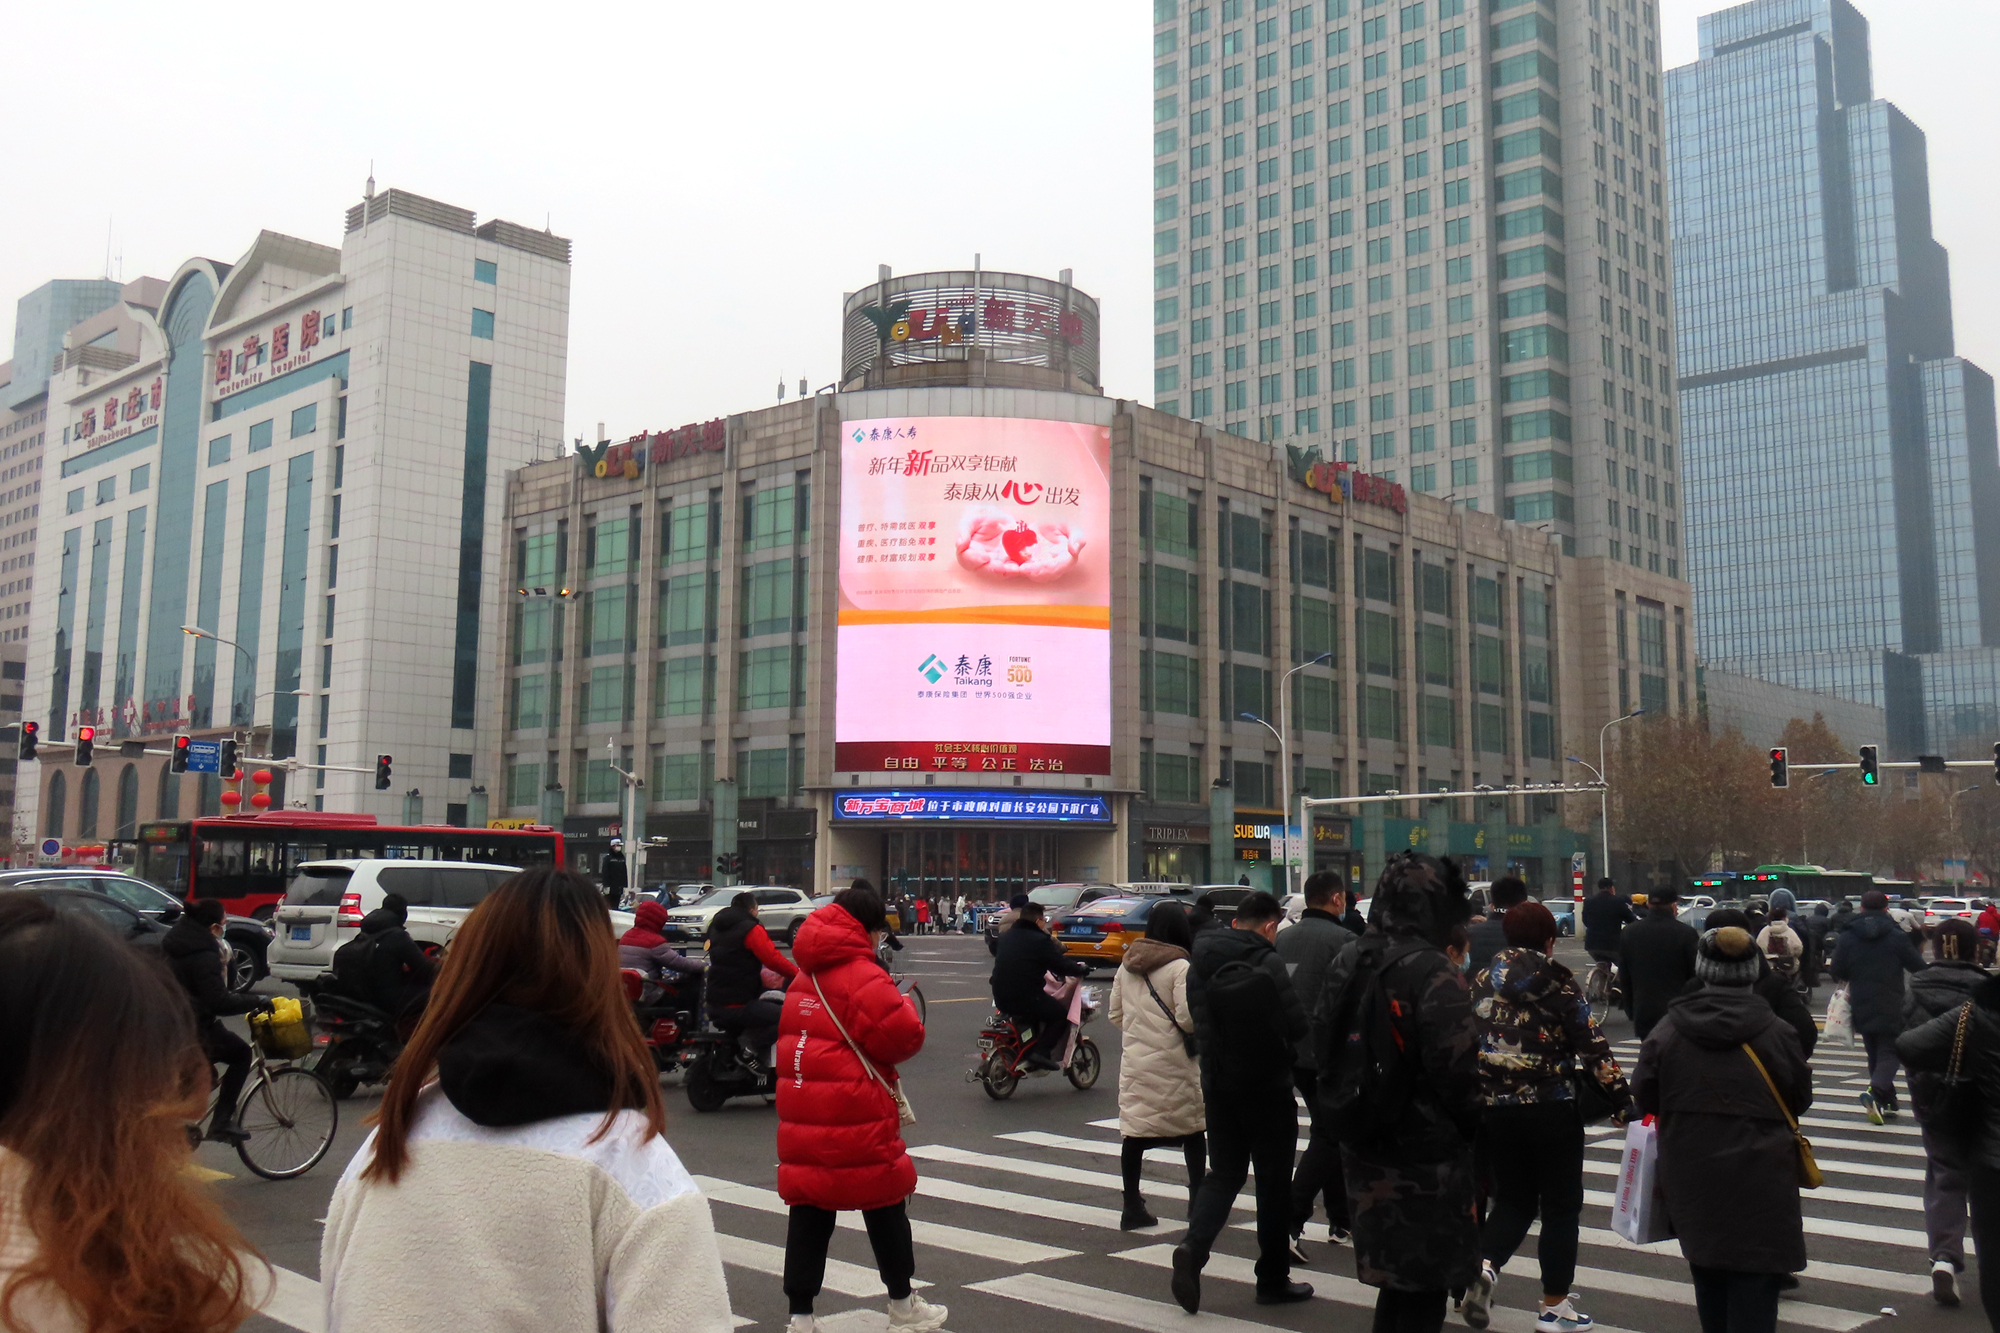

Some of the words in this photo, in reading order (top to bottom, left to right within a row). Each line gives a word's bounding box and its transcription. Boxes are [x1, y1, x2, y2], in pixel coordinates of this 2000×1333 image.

[983, 294, 1084, 345] 新天地
[214, 309, 321, 386] 妇产医院
[219, 372, 263, 396] maternity
[270, 351, 311, 376] hospital
[81, 376, 163, 440] 石家庄市
[653, 416, 726, 463] 新天地
[868, 425, 917, 442] 泰康人寿
[868, 449, 1018, 476] 新年新品双享钜献
[943, 479, 1081, 506] 泰康从心出发
[1352, 469, 1407, 514] 新天地
[954, 654, 993, 677] 泰康
[1007, 668, 1032, 683] 500
[954, 677, 993, 687] Taikang
[917, 690, 968, 699] 泰康保险集团
[975, 691, 1032, 700] 世界500强企业
[934, 743, 1018, 754] 社会主义核心价值观
[884, 757, 919, 769] 自由
[932, 756, 968, 770] 平等
[981, 757, 1017, 770] 公正
[1029, 758, 1063, 771] 法治
[844, 798, 925, 815] 新万宝商城
[1149, 827, 1190, 841] TRIPLEX
[1234, 825, 1271, 840] SUBWA
[793, 1050, 803, 1071] brave
